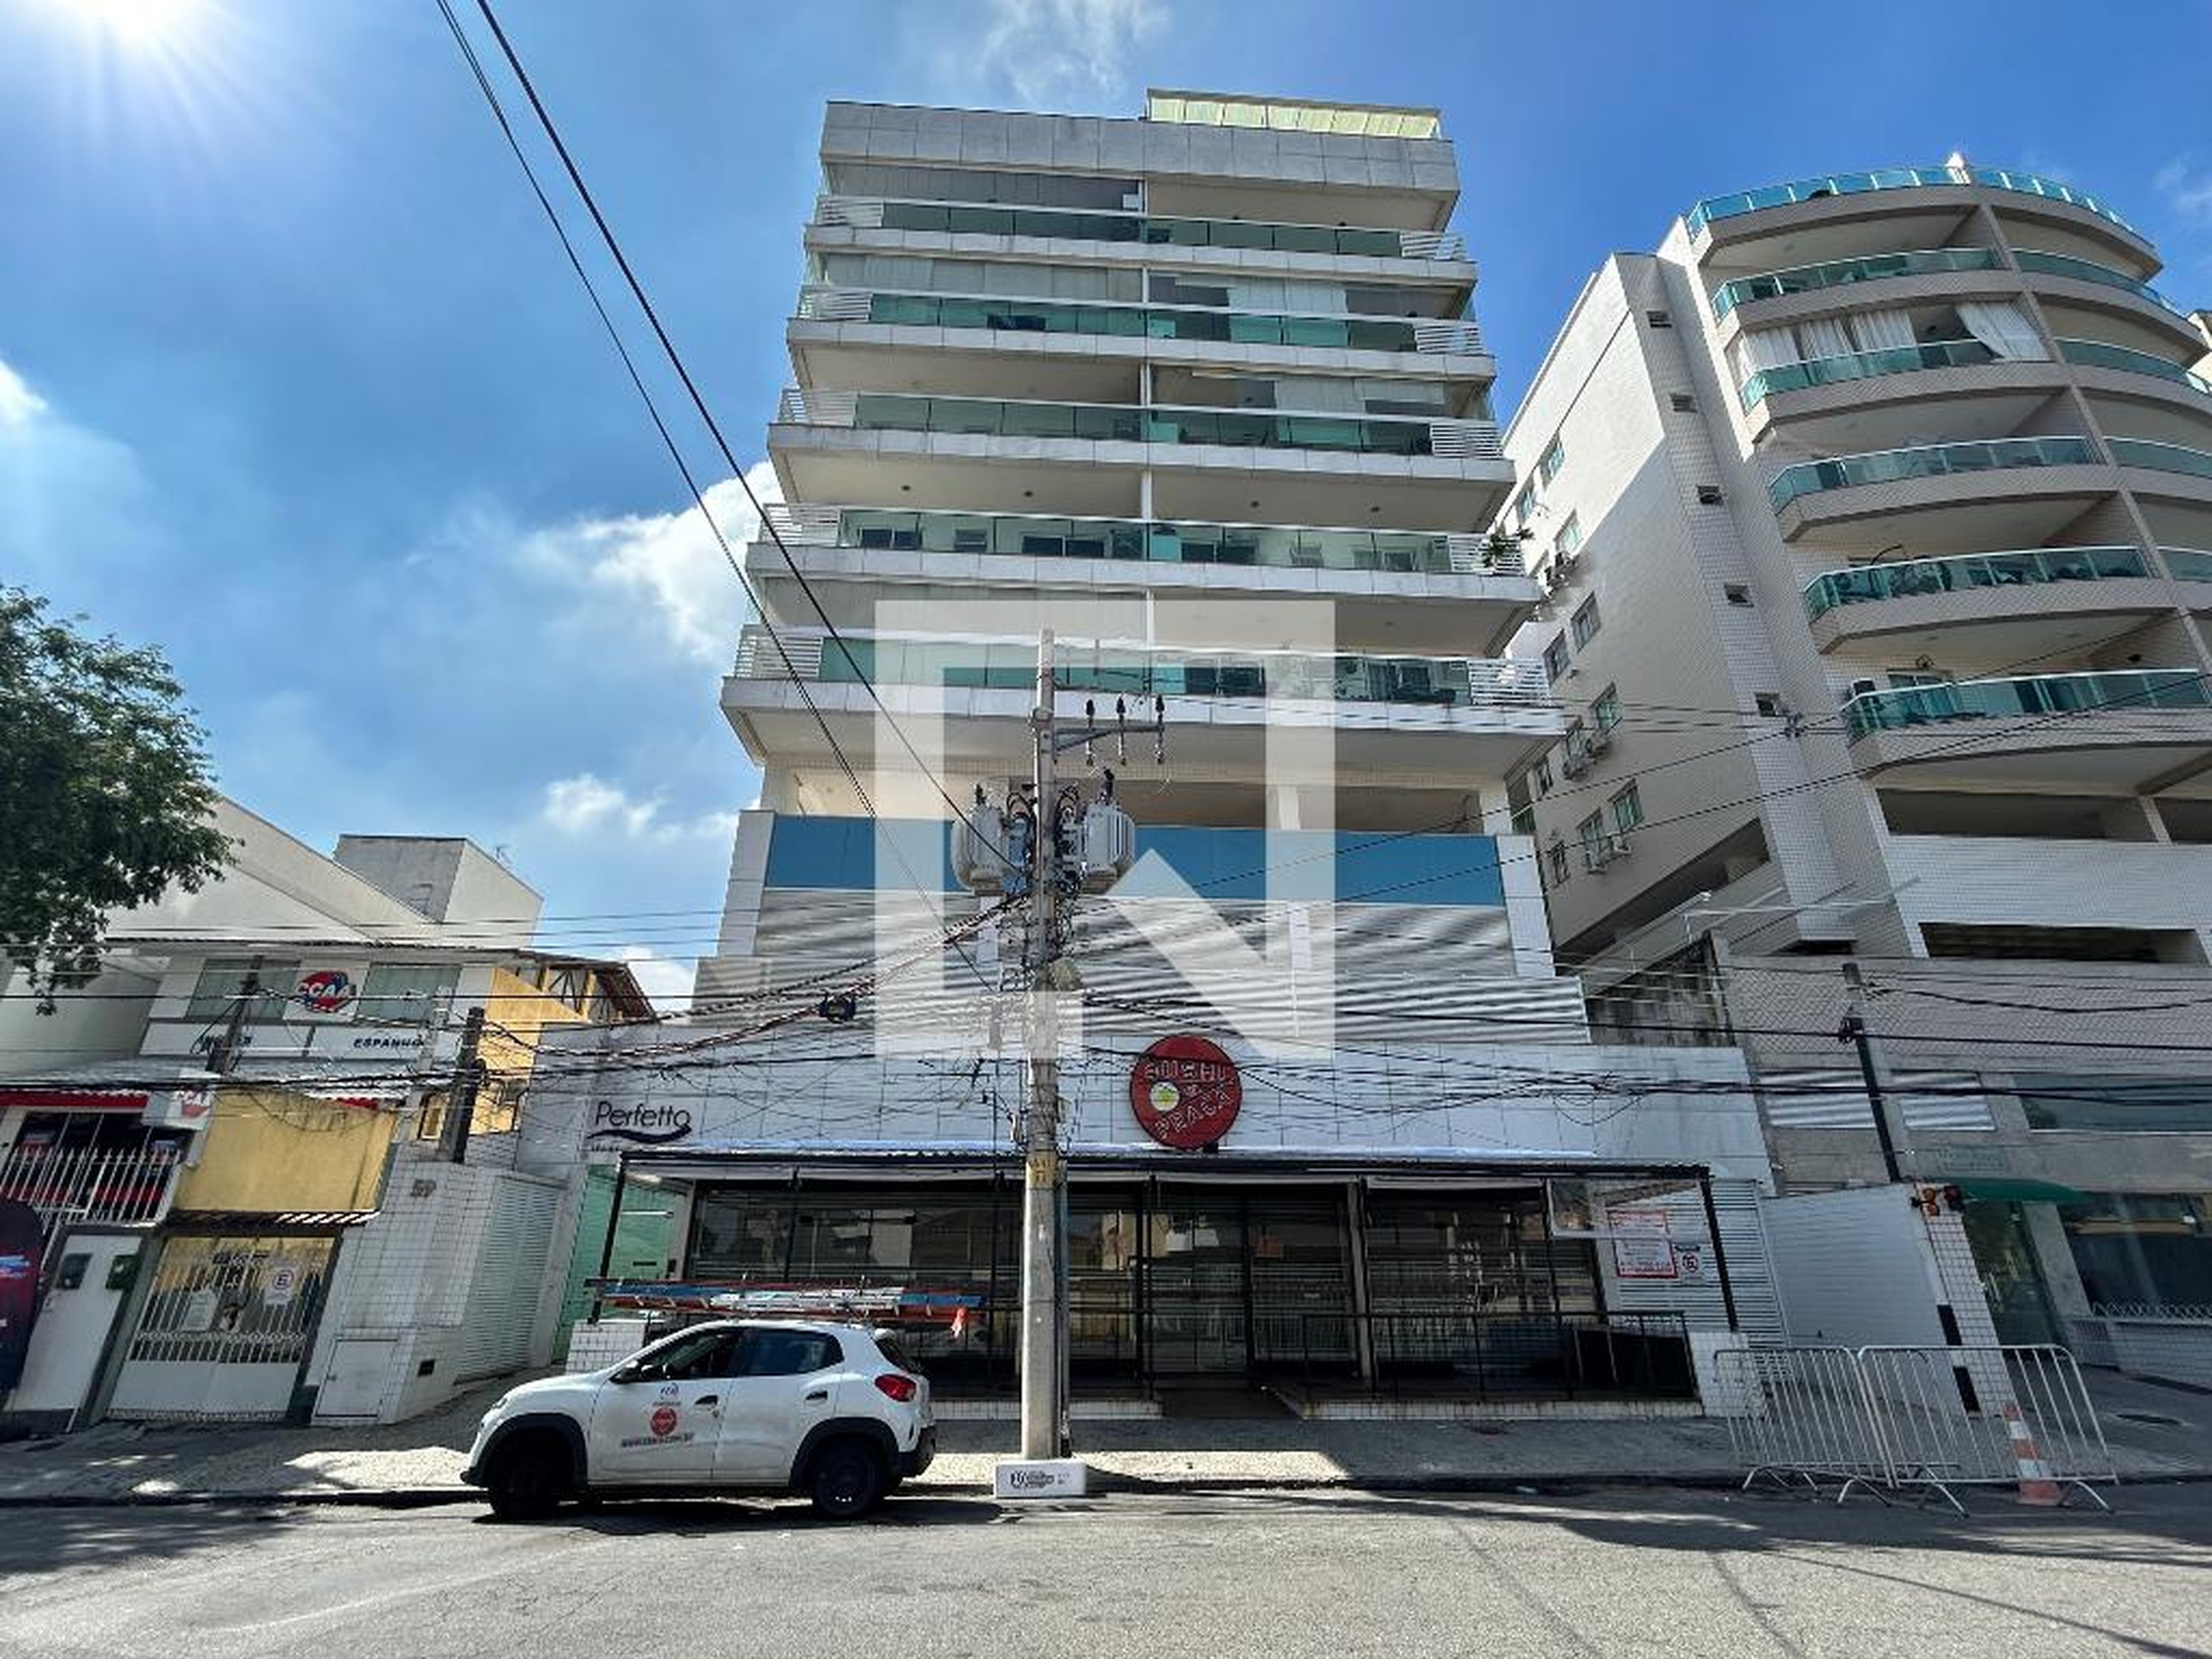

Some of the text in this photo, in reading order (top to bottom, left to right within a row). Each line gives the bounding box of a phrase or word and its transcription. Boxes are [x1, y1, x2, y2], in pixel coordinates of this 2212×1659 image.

[296, 982, 350, 998] CCAA
[353, 1037, 425, 1048] ESPANHO
[595, 1101, 691, 1127] Perfetto
